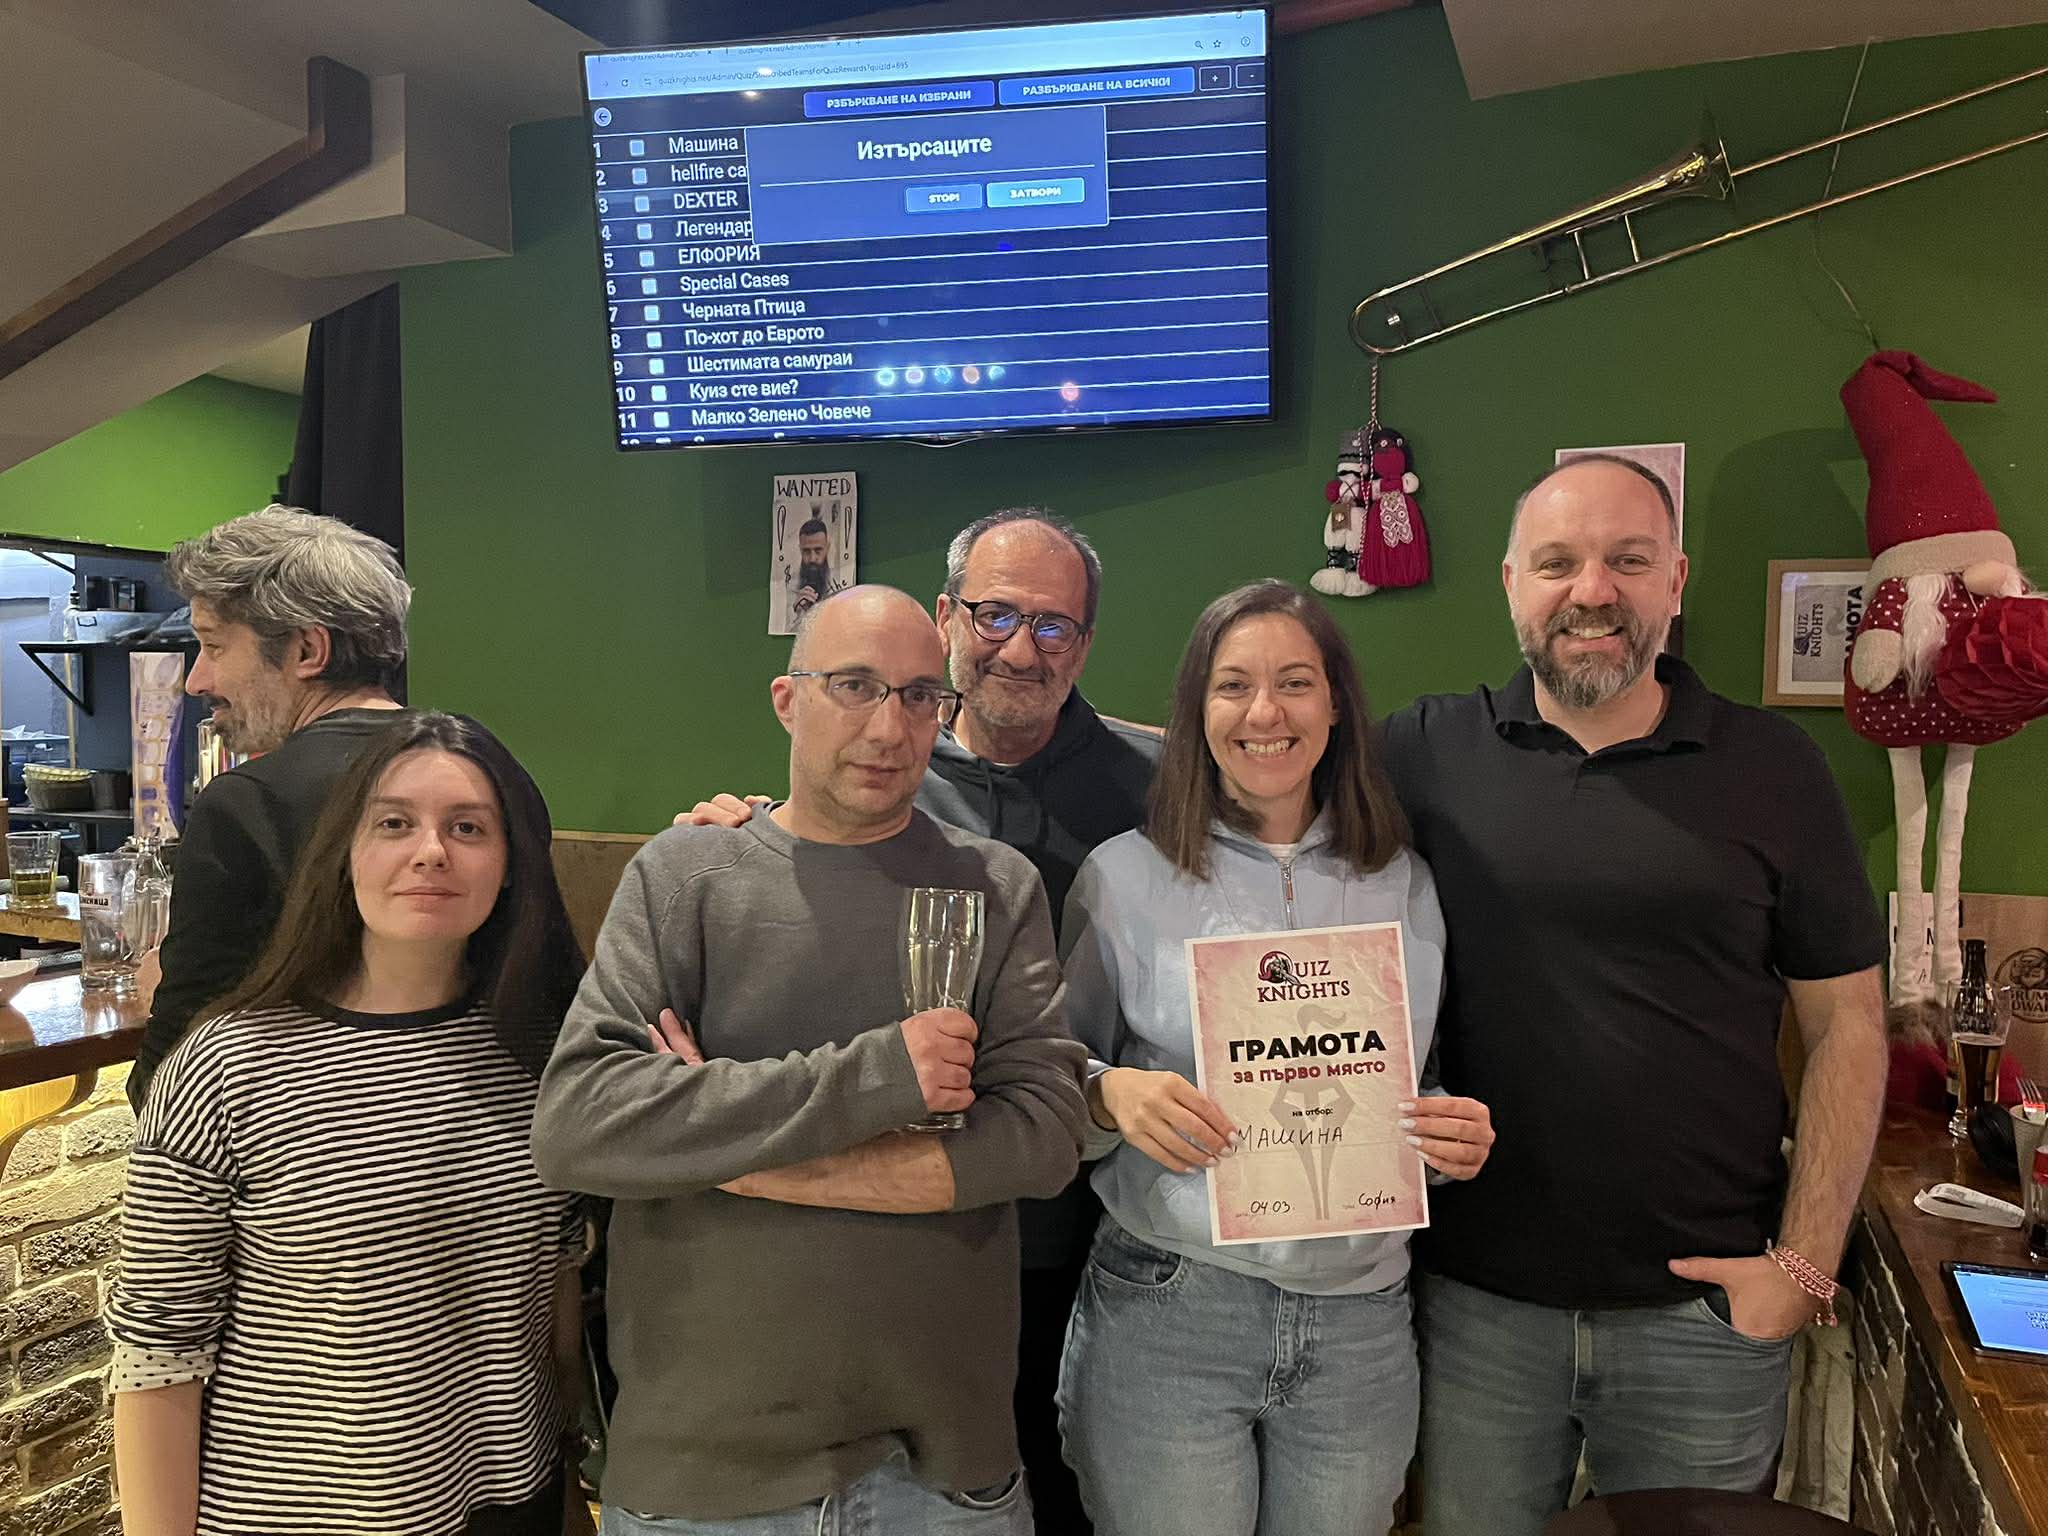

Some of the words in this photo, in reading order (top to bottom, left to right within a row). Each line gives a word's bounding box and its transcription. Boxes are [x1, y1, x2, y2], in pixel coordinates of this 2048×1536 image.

[1023, 81, 1104, 96] РАЗБЪРКВАНЕ
[1106, 80, 1123, 91] НА
[1125, 77, 1171, 89] ВСИЧКИ
[827, 95, 899, 108] РЗБЪРКВАНЕ
[900, 94, 917, 104] НА
[919, 90, 972, 102] ИЗБРАНИ
[669, 137, 739, 154] Машина
[857, 136, 992, 161] Изтърсаците
[596, 170, 606, 186] 2
[671, 164, 724, 182] hellfire
[728, 165, 748, 179] ca
[673, 191, 738, 210] DEXTER
[1009, 187, 1061, 199] ЗАТВОРИ
[599, 198, 609, 214] 3
[601, 225, 612, 241] 4
[604, 253, 614, 269] 5
[678, 244, 761, 265] ЕЛФОРИЯ
[606, 280, 617, 296] 6
[680, 274, 738, 295] Special
[740, 273, 790, 289] Cases
[608, 306, 618, 322] 7
[682, 301, 751, 321] Черната
[754, 299, 806, 317] Птица
[611, 333, 621, 349] 8
[685, 329, 739, 346] По-хот
[742, 330, 763, 346] до
[767, 325, 825, 344] Еврото
[613, 360, 623, 376] 9
[687, 354, 780, 373] Шестимата
[783, 352, 853, 371] самураи
[616, 386, 636, 402] 10
[689, 382, 728, 401] Куиз
[731, 384, 758, 398] сте
[761, 379, 799, 398] вие?
[619, 412, 637, 428] 11
[692, 407, 747, 427] Малко
[749, 405, 808, 424] Зелено
[811, 403, 871, 421] Човече
[776, 478, 852, 498] WANTED
[1810, 603, 1824, 657] KNIGHTS
[1257, 980, 1351, 1003] KNIGHTS
[1229, 1030, 1386, 1063] ГРАМОТА
[1233, 1071, 1254, 1084] за
[1260, 1066, 1321, 1083] първо
[1327, 1060, 1386, 1077] място
[1292, 1109, 1303, 1117] на
[1305, 1107, 1333, 1119] отбор:
[1358, 1190, 1396, 1210] София
